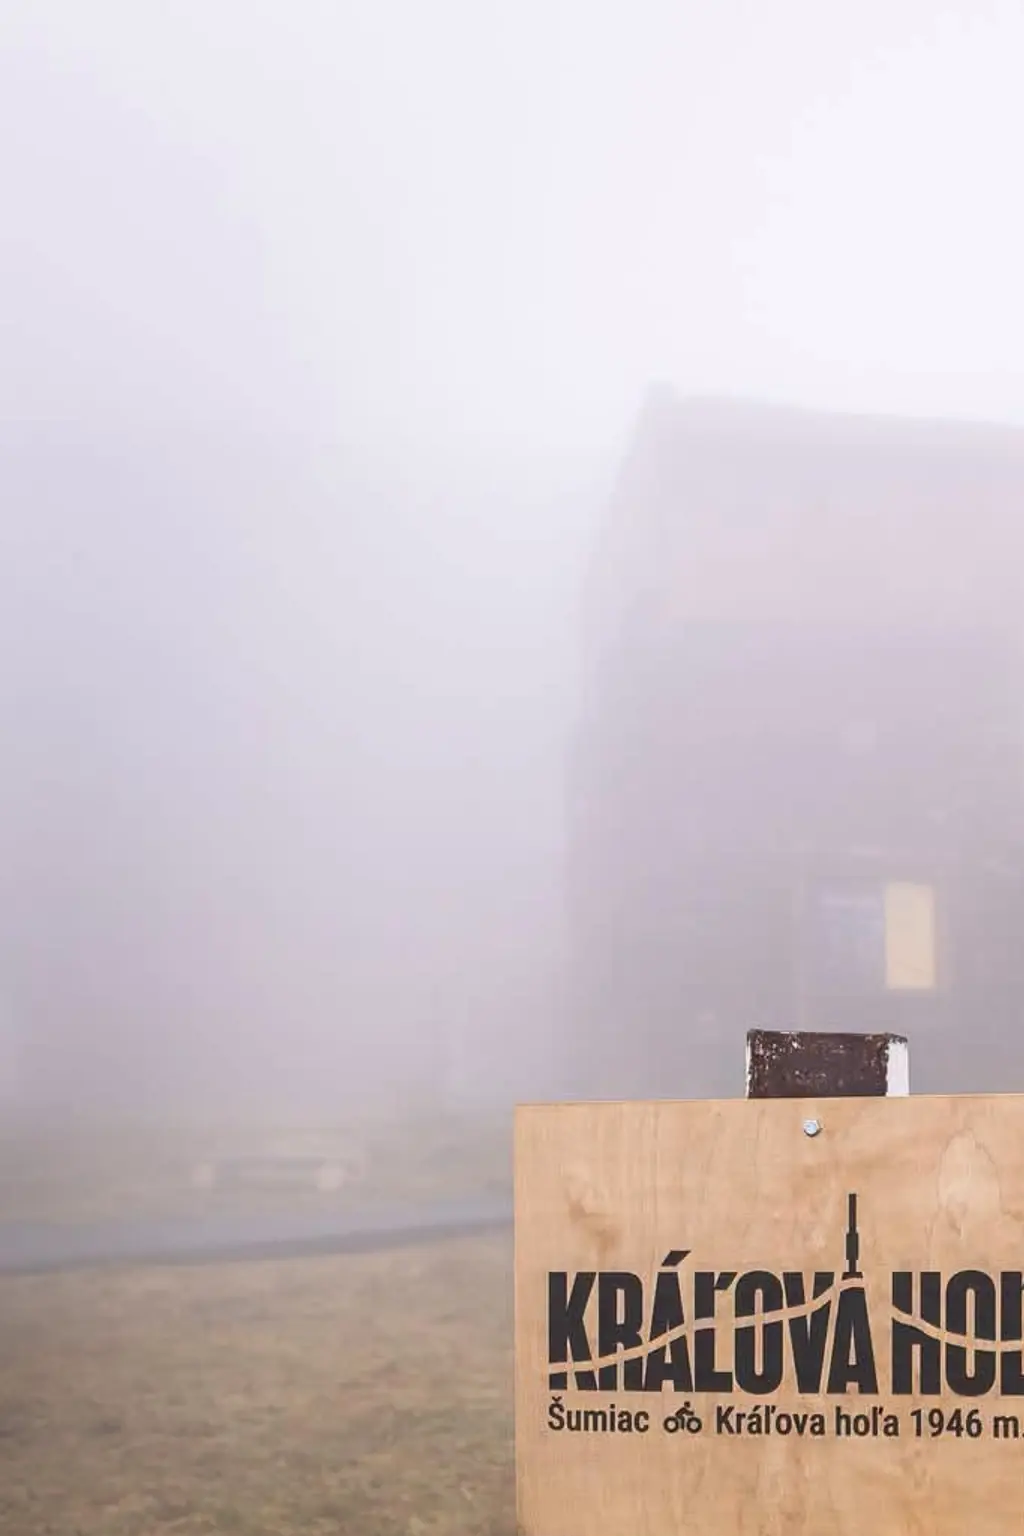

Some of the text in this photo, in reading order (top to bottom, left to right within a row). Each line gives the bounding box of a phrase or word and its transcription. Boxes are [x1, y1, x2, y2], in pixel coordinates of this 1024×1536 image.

[546, 1395, 651, 1434] Šumiac
[715, 1404, 827, 1437] Kráľova
[834, 1405, 901, 1438] hoľa
[909, 1407, 984, 1439] 1946
